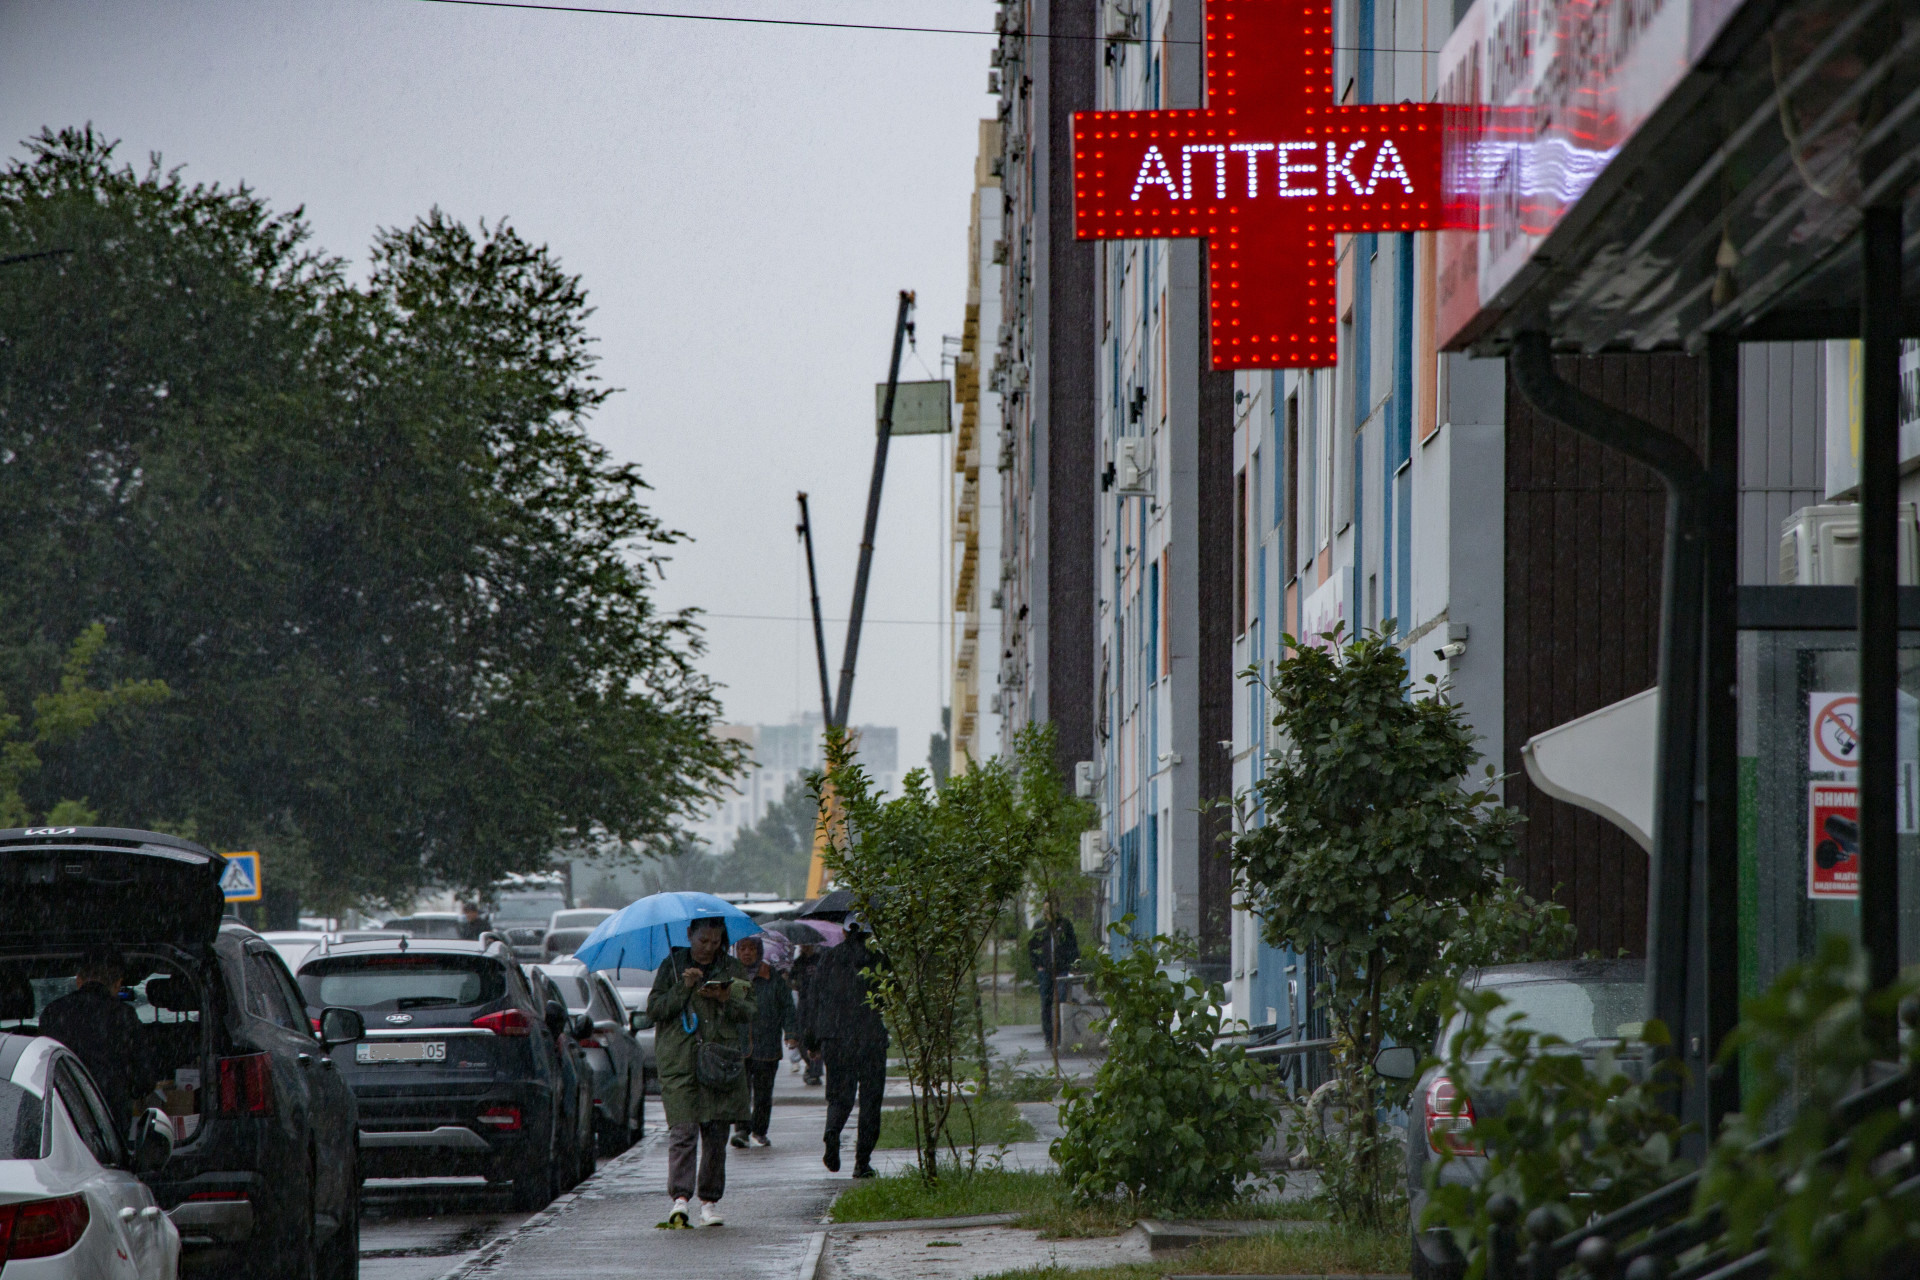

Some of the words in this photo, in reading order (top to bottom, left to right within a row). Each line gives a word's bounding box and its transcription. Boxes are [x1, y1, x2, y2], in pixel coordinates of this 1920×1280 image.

[1129, 139, 1414, 202] АПТЕКА
[1814, 791, 1858, 807] ВНИМ
[426, 1044, 445, 1058] 05
